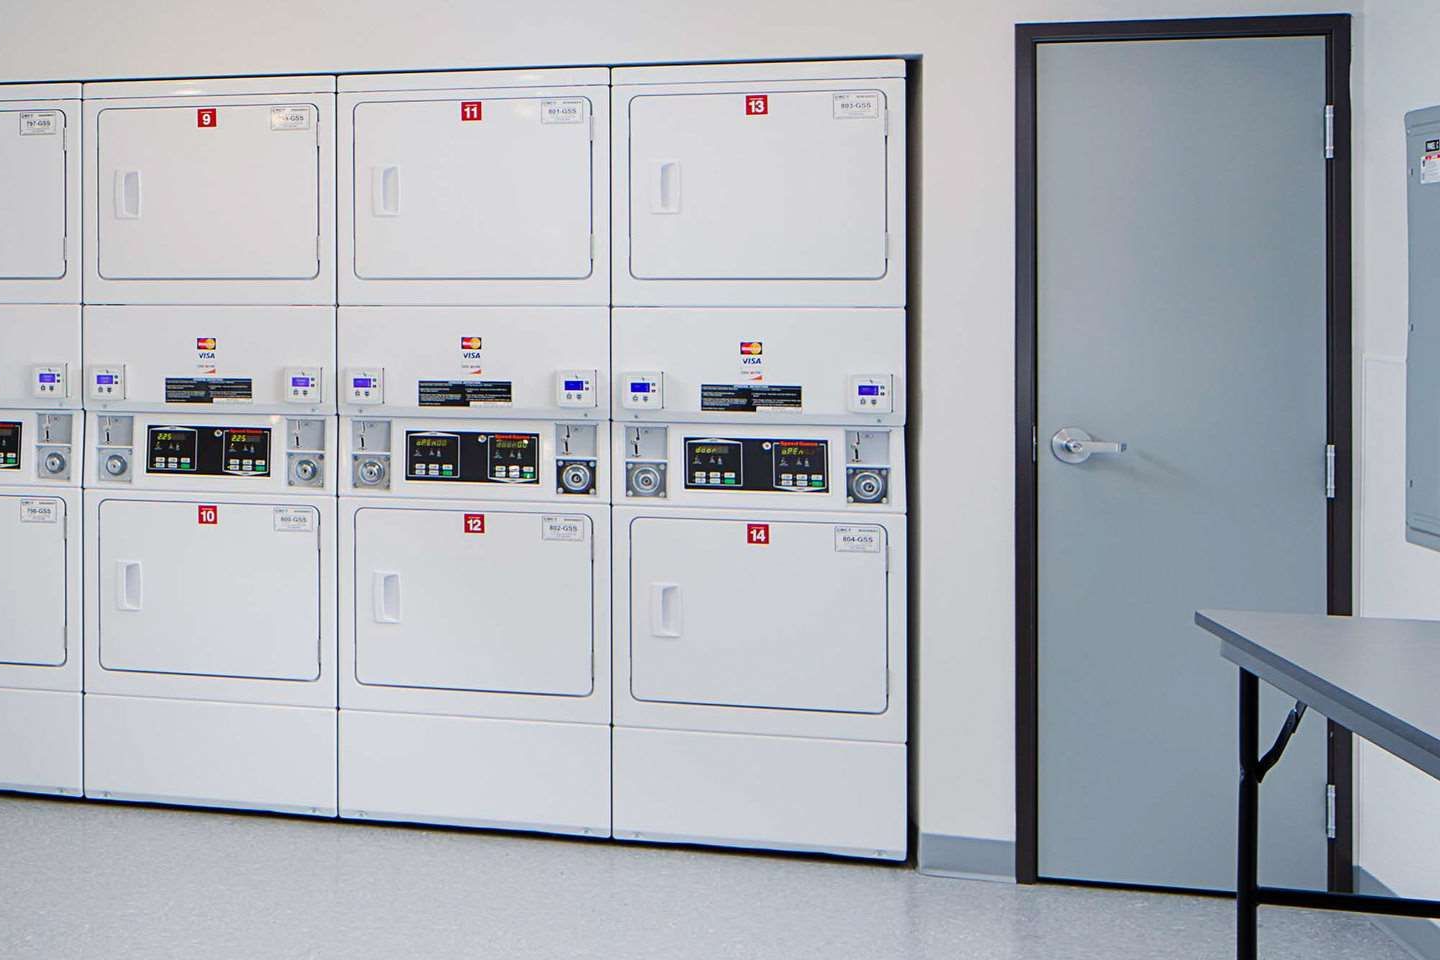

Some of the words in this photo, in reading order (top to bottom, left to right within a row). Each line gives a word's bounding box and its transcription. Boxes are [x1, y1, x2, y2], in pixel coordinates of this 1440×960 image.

[464, 106, 478, 119] 11
[749, 100, 765, 113] 13
[202, 113, 211, 125] 9
[201, 510, 215, 522] 10
[467, 519, 482, 531] 12
[750, 529, 766, 542] 14
